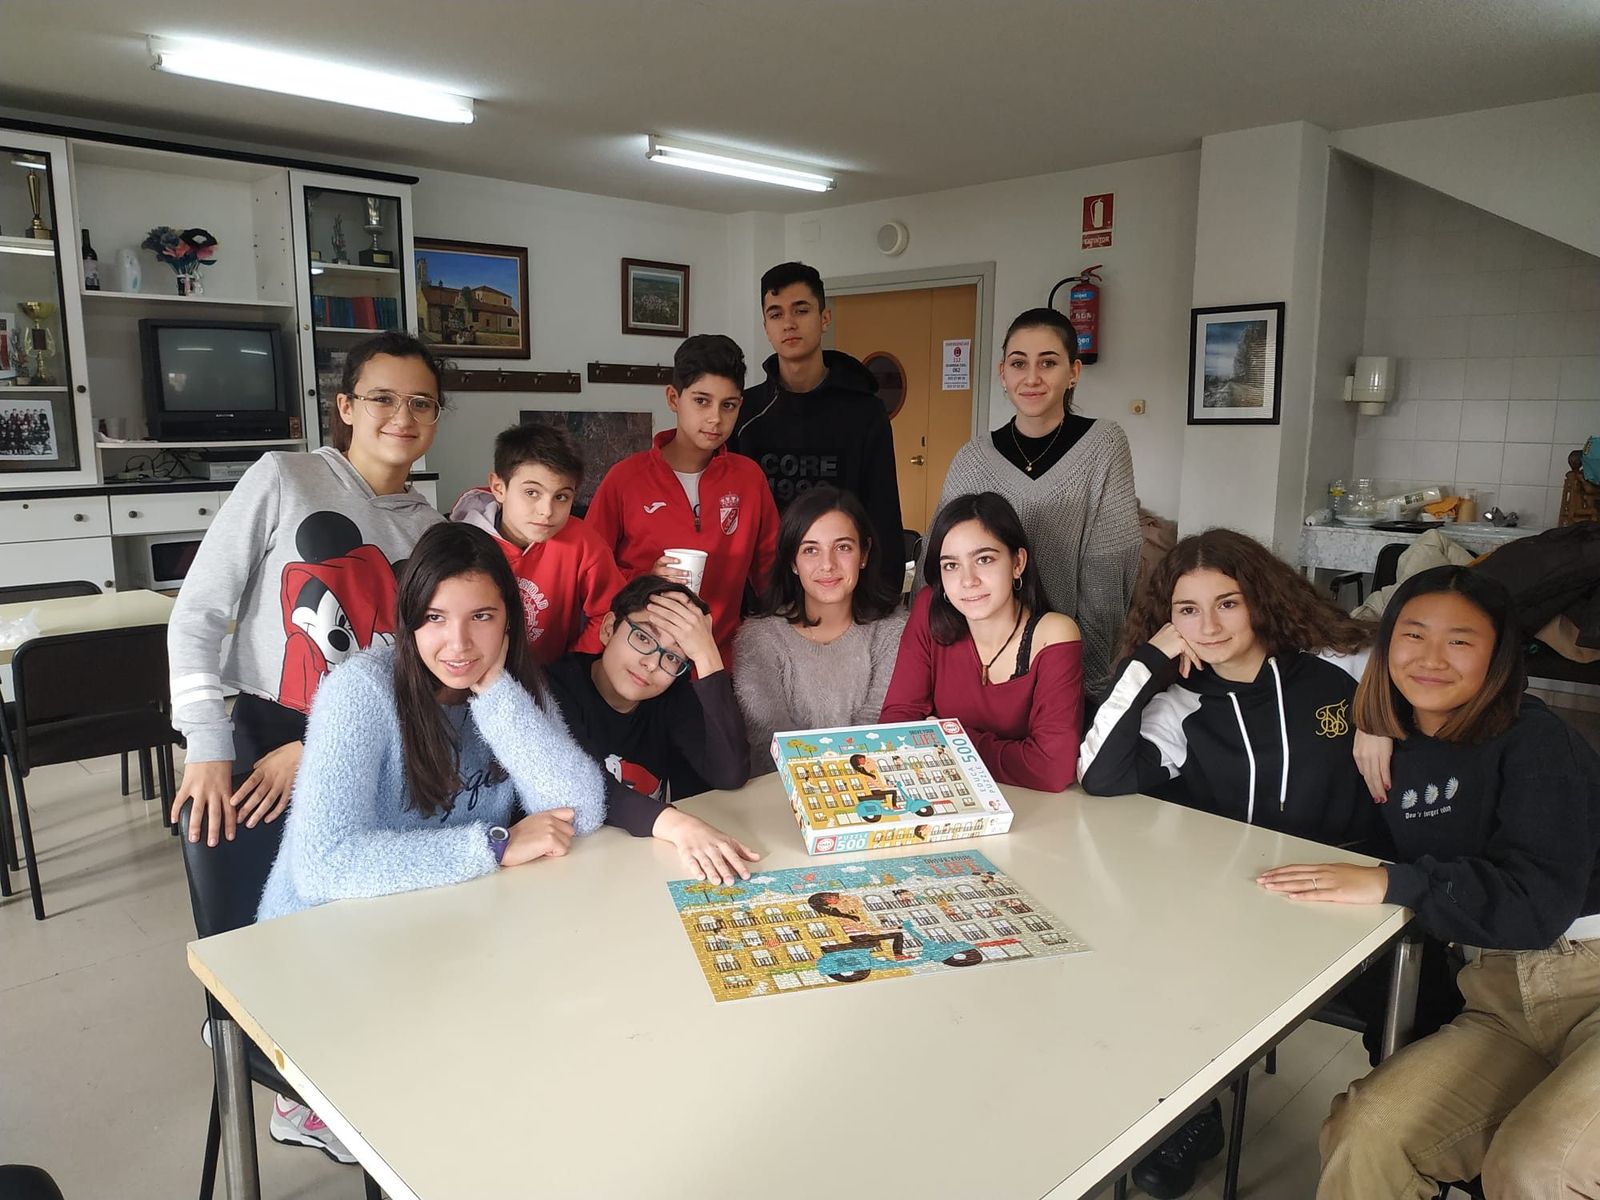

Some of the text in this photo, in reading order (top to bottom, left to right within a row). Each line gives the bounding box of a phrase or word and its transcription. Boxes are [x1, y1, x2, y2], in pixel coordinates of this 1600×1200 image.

[761, 453, 838, 477] CORE
[952, 738, 978, 764] 500
[968, 766, 987, 793] EDUCA
[976, 765, 996, 794] PUZZLE
[837, 838, 866, 850] 500
[838, 832, 869, 840] PUZZLE
